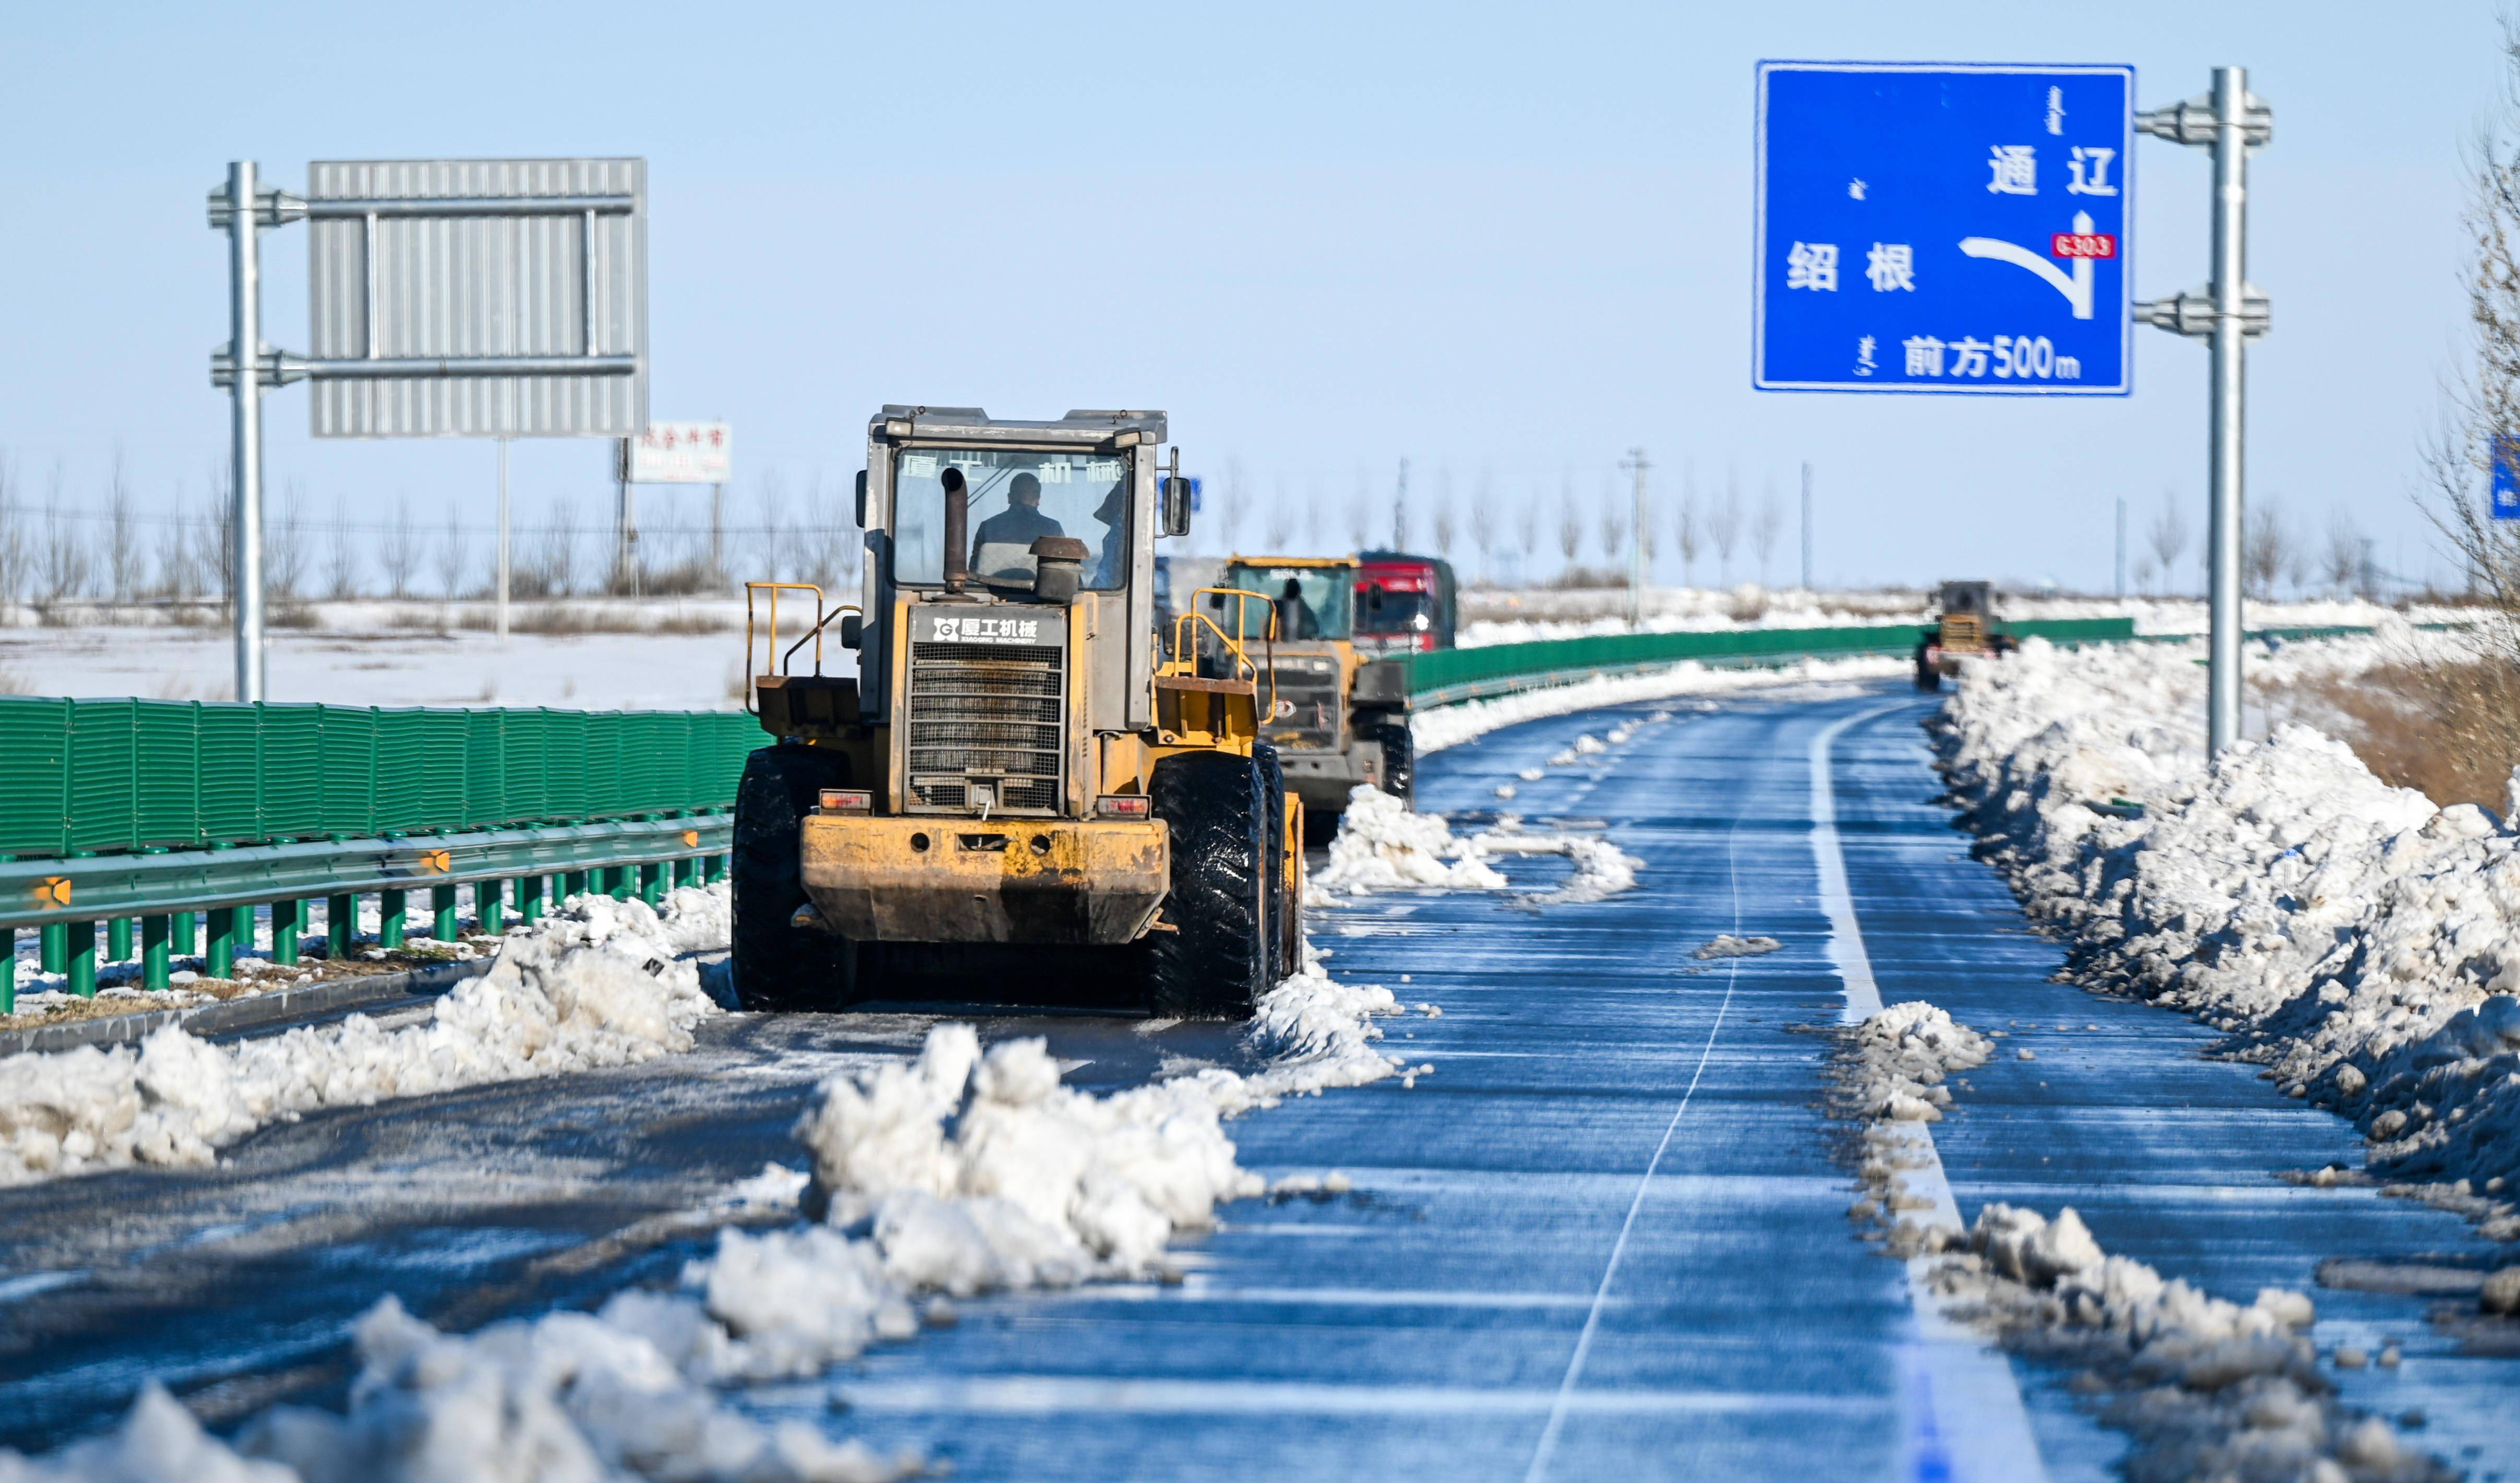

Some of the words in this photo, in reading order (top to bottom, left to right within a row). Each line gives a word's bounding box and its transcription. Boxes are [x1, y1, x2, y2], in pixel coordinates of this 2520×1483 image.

[1987, 145, 2118, 197] 通辽
[1786, 241, 1916, 292] 绍根
[1902, 335, 2081, 379] 前方500m
[961, 618, 1038, 638] 厦工机械
